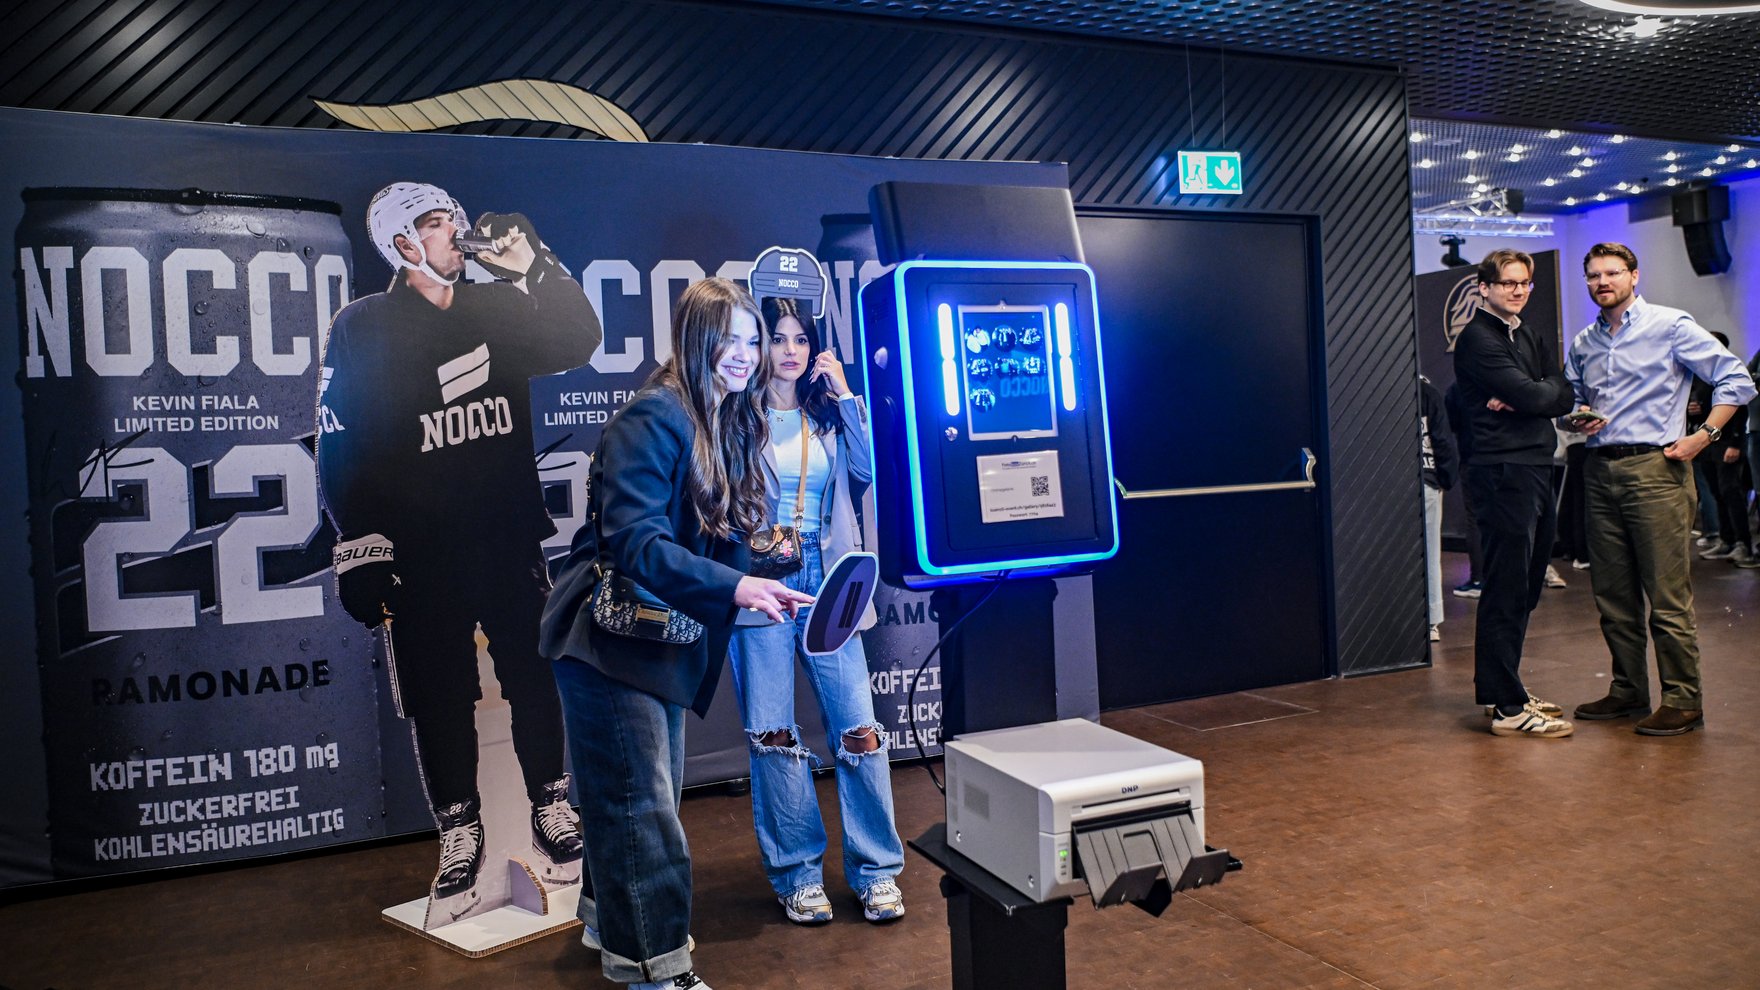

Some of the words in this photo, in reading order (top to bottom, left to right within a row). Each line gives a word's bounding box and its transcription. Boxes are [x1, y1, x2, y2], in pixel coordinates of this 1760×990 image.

[780, 256, 798, 272] 22
[778, 278, 799, 288] NOCCO
[133, 396, 195, 411] KEVIN
[201, 395, 260, 410] FIALA
[560, 391, 608, 406] KEVIN
[613, 390, 640, 404] FIA
[114, 417, 195, 433] LIMITED
[200, 415, 279, 431] EDITION
[420, 396, 513, 453] NOCCO
[544, 410, 608, 426] LIMITED
[79, 443, 324, 632] 22
[91, 660, 332, 706] RAMONADE
[868, 666, 942, 695] KOFFEI
[89, 752, 233, 792] KOFFEIN
[243, 744, 297, 775] 180
[306, 742, 340, 769] mg
[1121, 785, 1139, 794] DNP
[139, 785, 300, 826] ZUCKERFREI
[449, 803, 462, 815] 22
[94, 808, 345, 862] KOHLENSÄUREHALTIG
